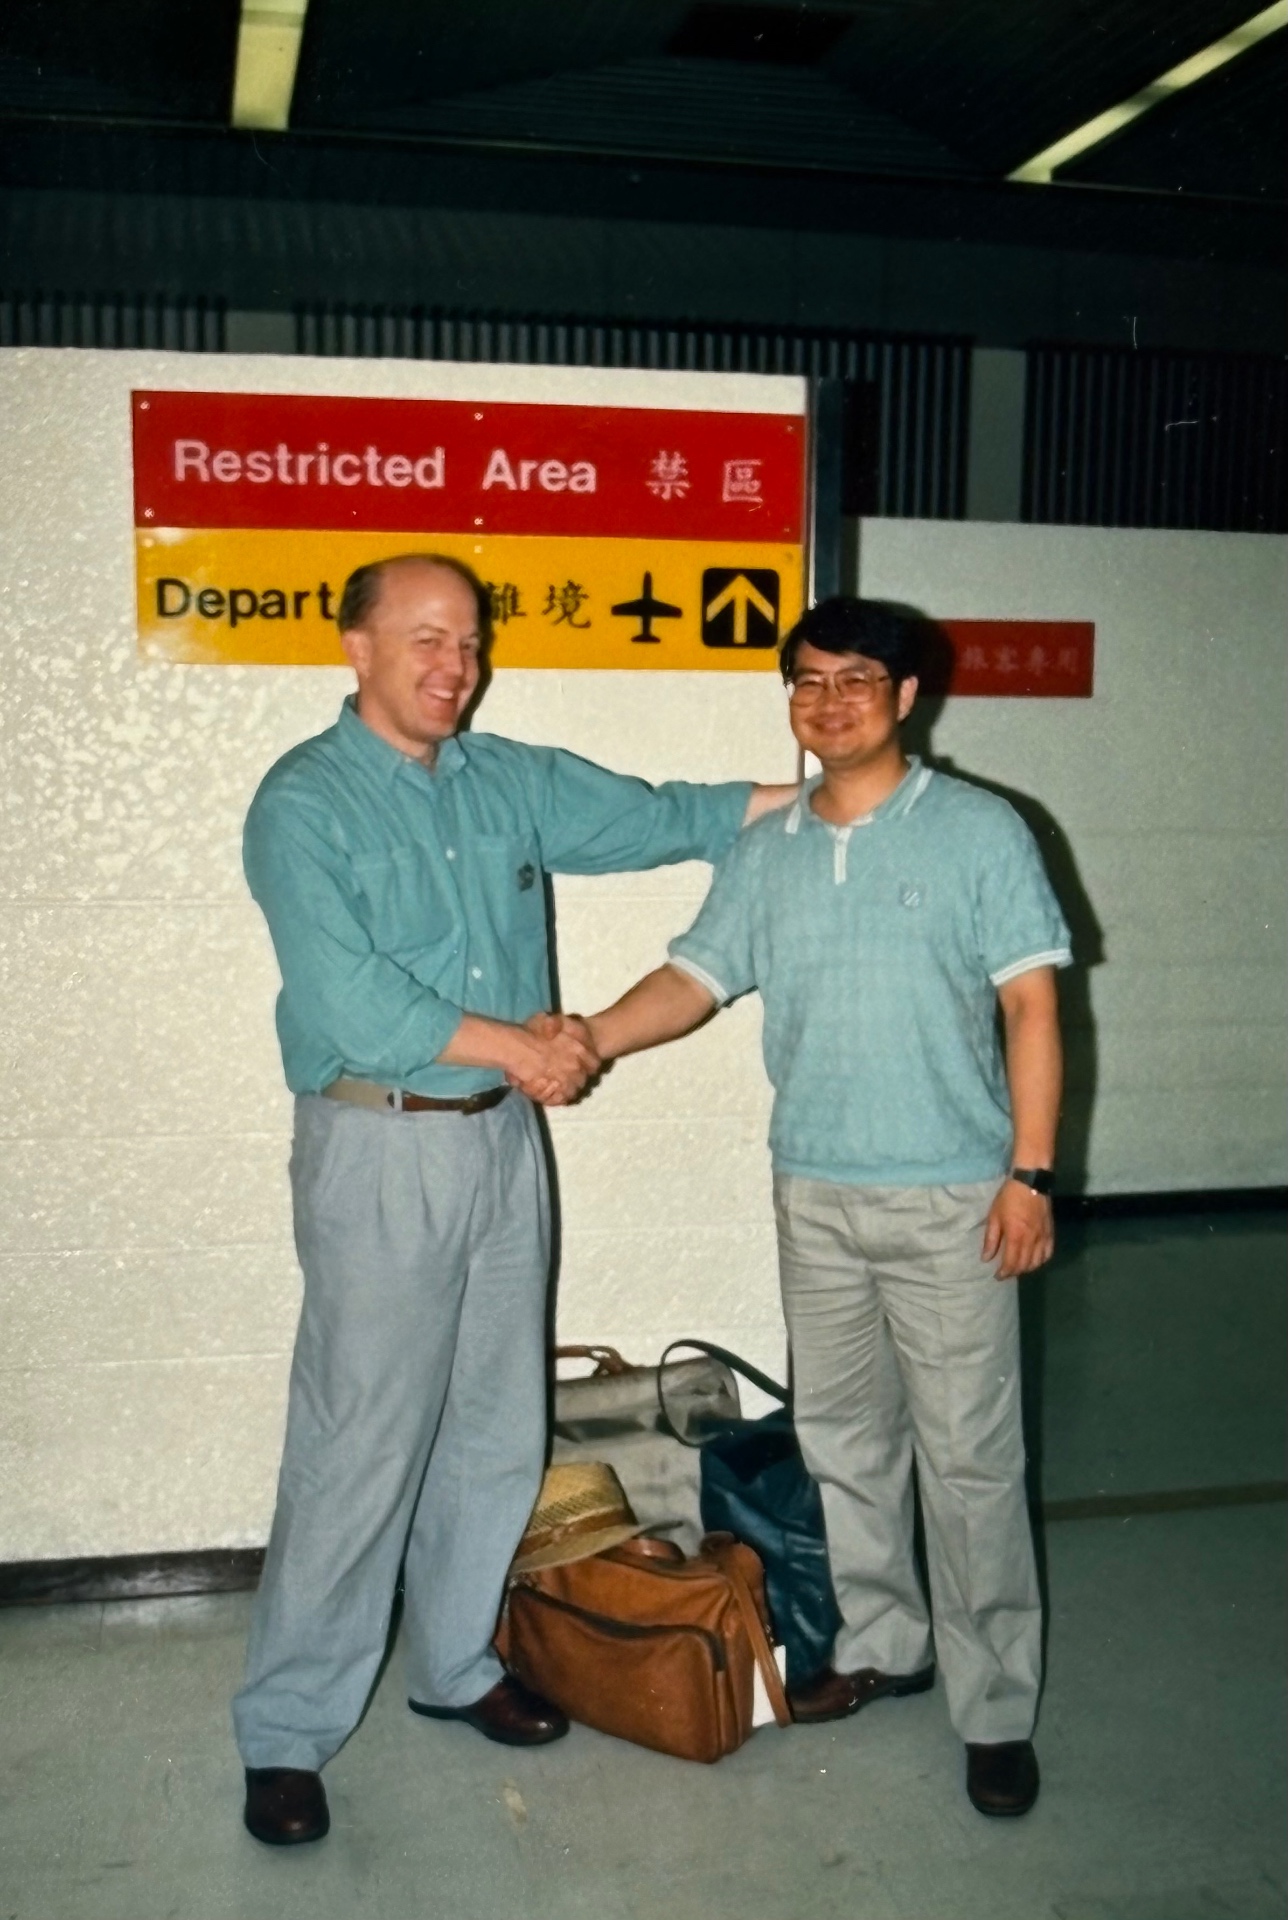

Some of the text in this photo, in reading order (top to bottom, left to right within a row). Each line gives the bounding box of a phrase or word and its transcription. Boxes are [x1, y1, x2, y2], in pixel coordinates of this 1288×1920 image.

[174, 438, 597, 493] Restricted Area
[645, 449, 764, 503] 禁區
[156, 577, 335, 629] Depart
